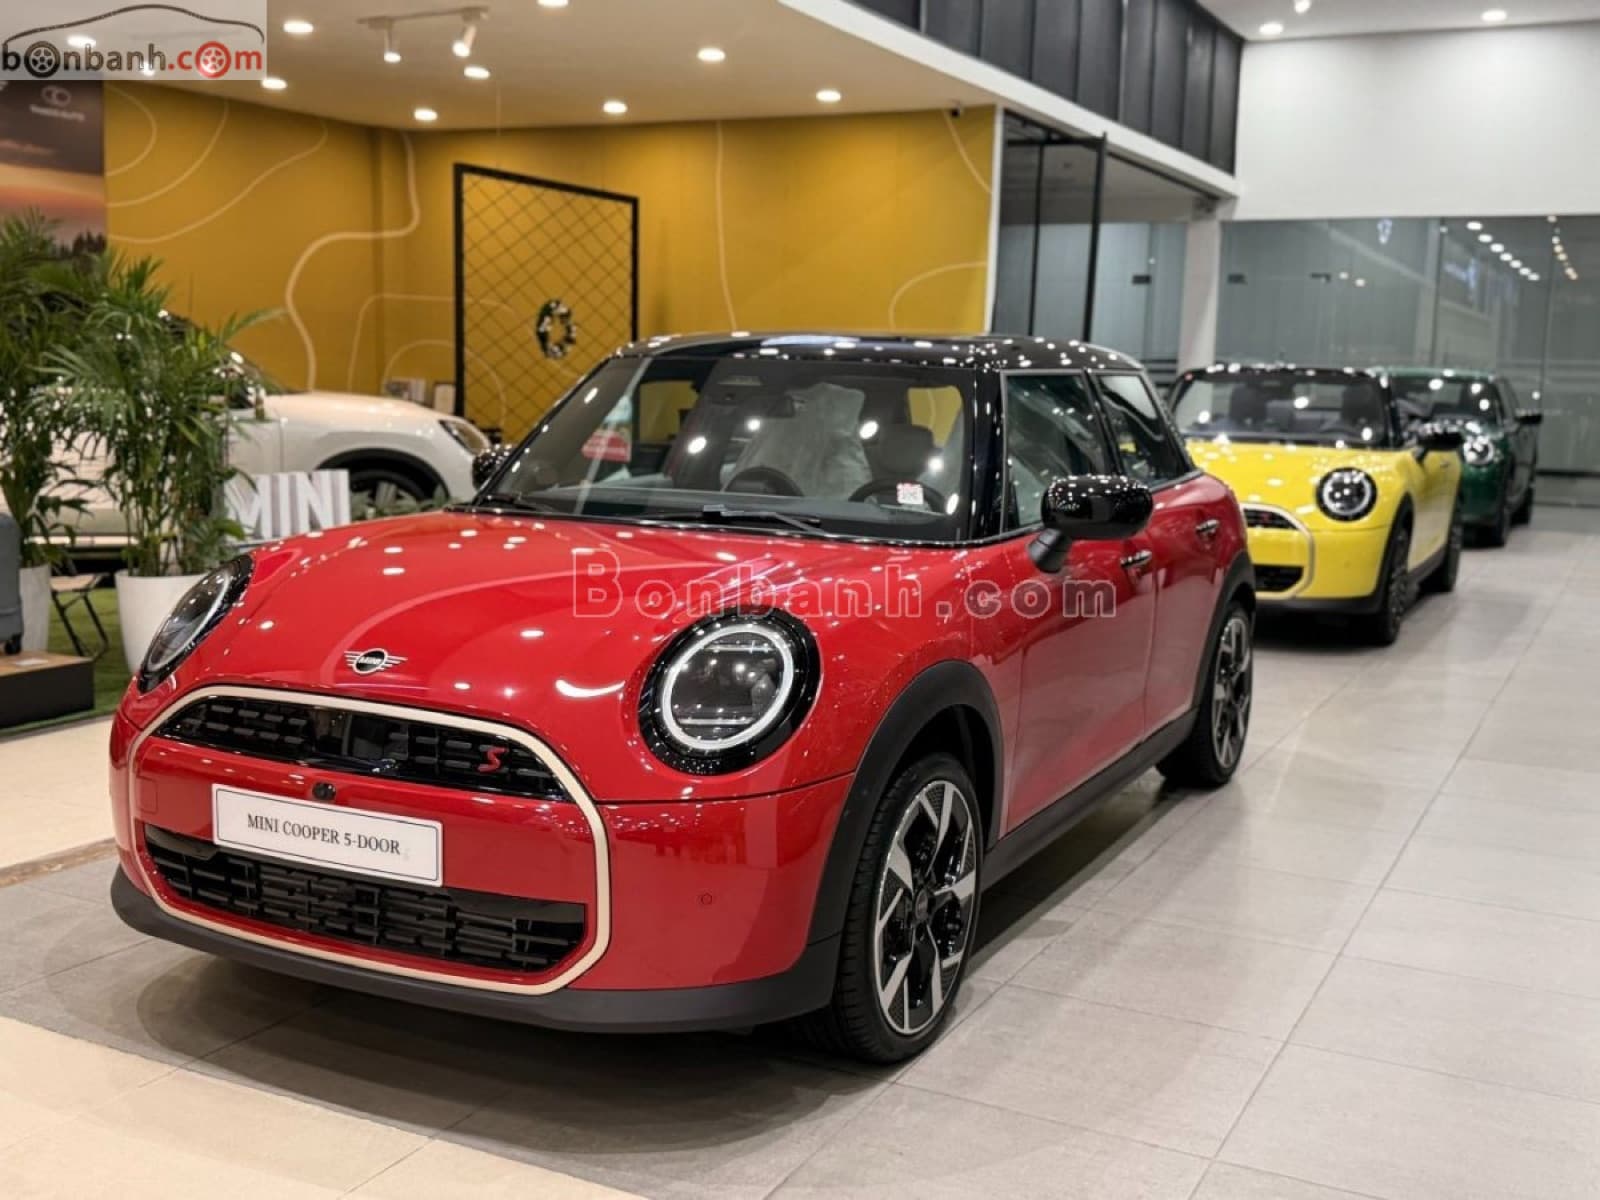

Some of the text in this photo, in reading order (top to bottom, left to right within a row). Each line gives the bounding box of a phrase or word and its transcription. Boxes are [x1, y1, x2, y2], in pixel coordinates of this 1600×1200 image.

[224, 469, 350, 540] MINI
[478, 747, 507, 772] S
[247, 813, 401, 855] MINI COOPER 5-DOOR
